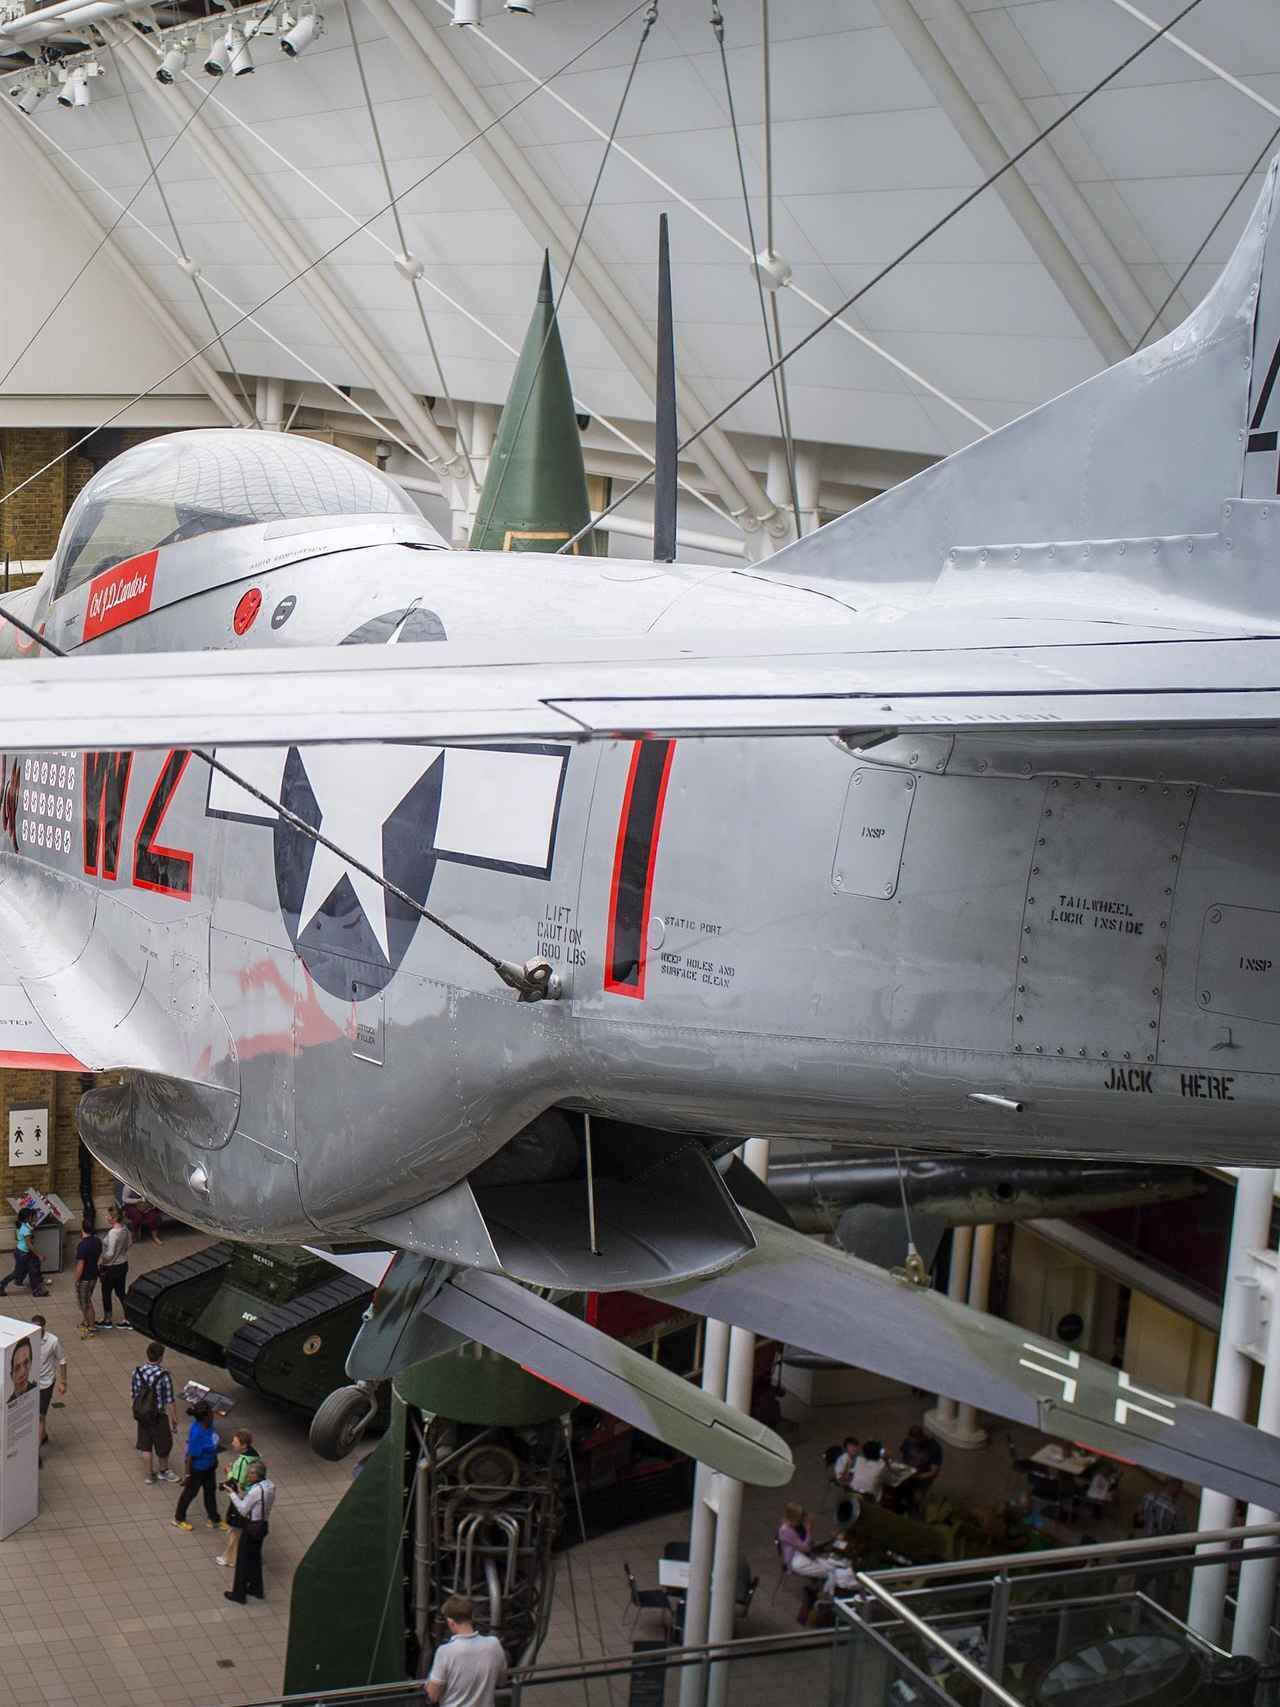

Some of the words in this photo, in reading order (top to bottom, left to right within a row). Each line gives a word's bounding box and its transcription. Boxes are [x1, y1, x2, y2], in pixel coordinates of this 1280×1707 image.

[862, 827, 886, 839] INSP
[544, 903, 571, 924] LIFT
[1060, 895, 1133, 917] TAILWHEEL
[537, 921, 582, 945] CAUTION
[664, 916, 695, 930] STATIC
[700, 922, 722, 935] PORT
[1050, 909, 1083, 925] LOCK
[1094, 916, 1144, 935] INSIDE
[566, 946, 586, 967] LBS
[660, 951, 681, 964] KEEP
[686, 958, 713, 972] HOLES
[719, 965, 735, 977] AND
[1239, 957, 1272, 972] INSP
[661, 964, 697, 981] SURFACE
[702, 973, 730, 989] CLEAN
[1104, 1067, 1153, 1094] JACK
[1180, 1072, 1236, 1101] HERE
